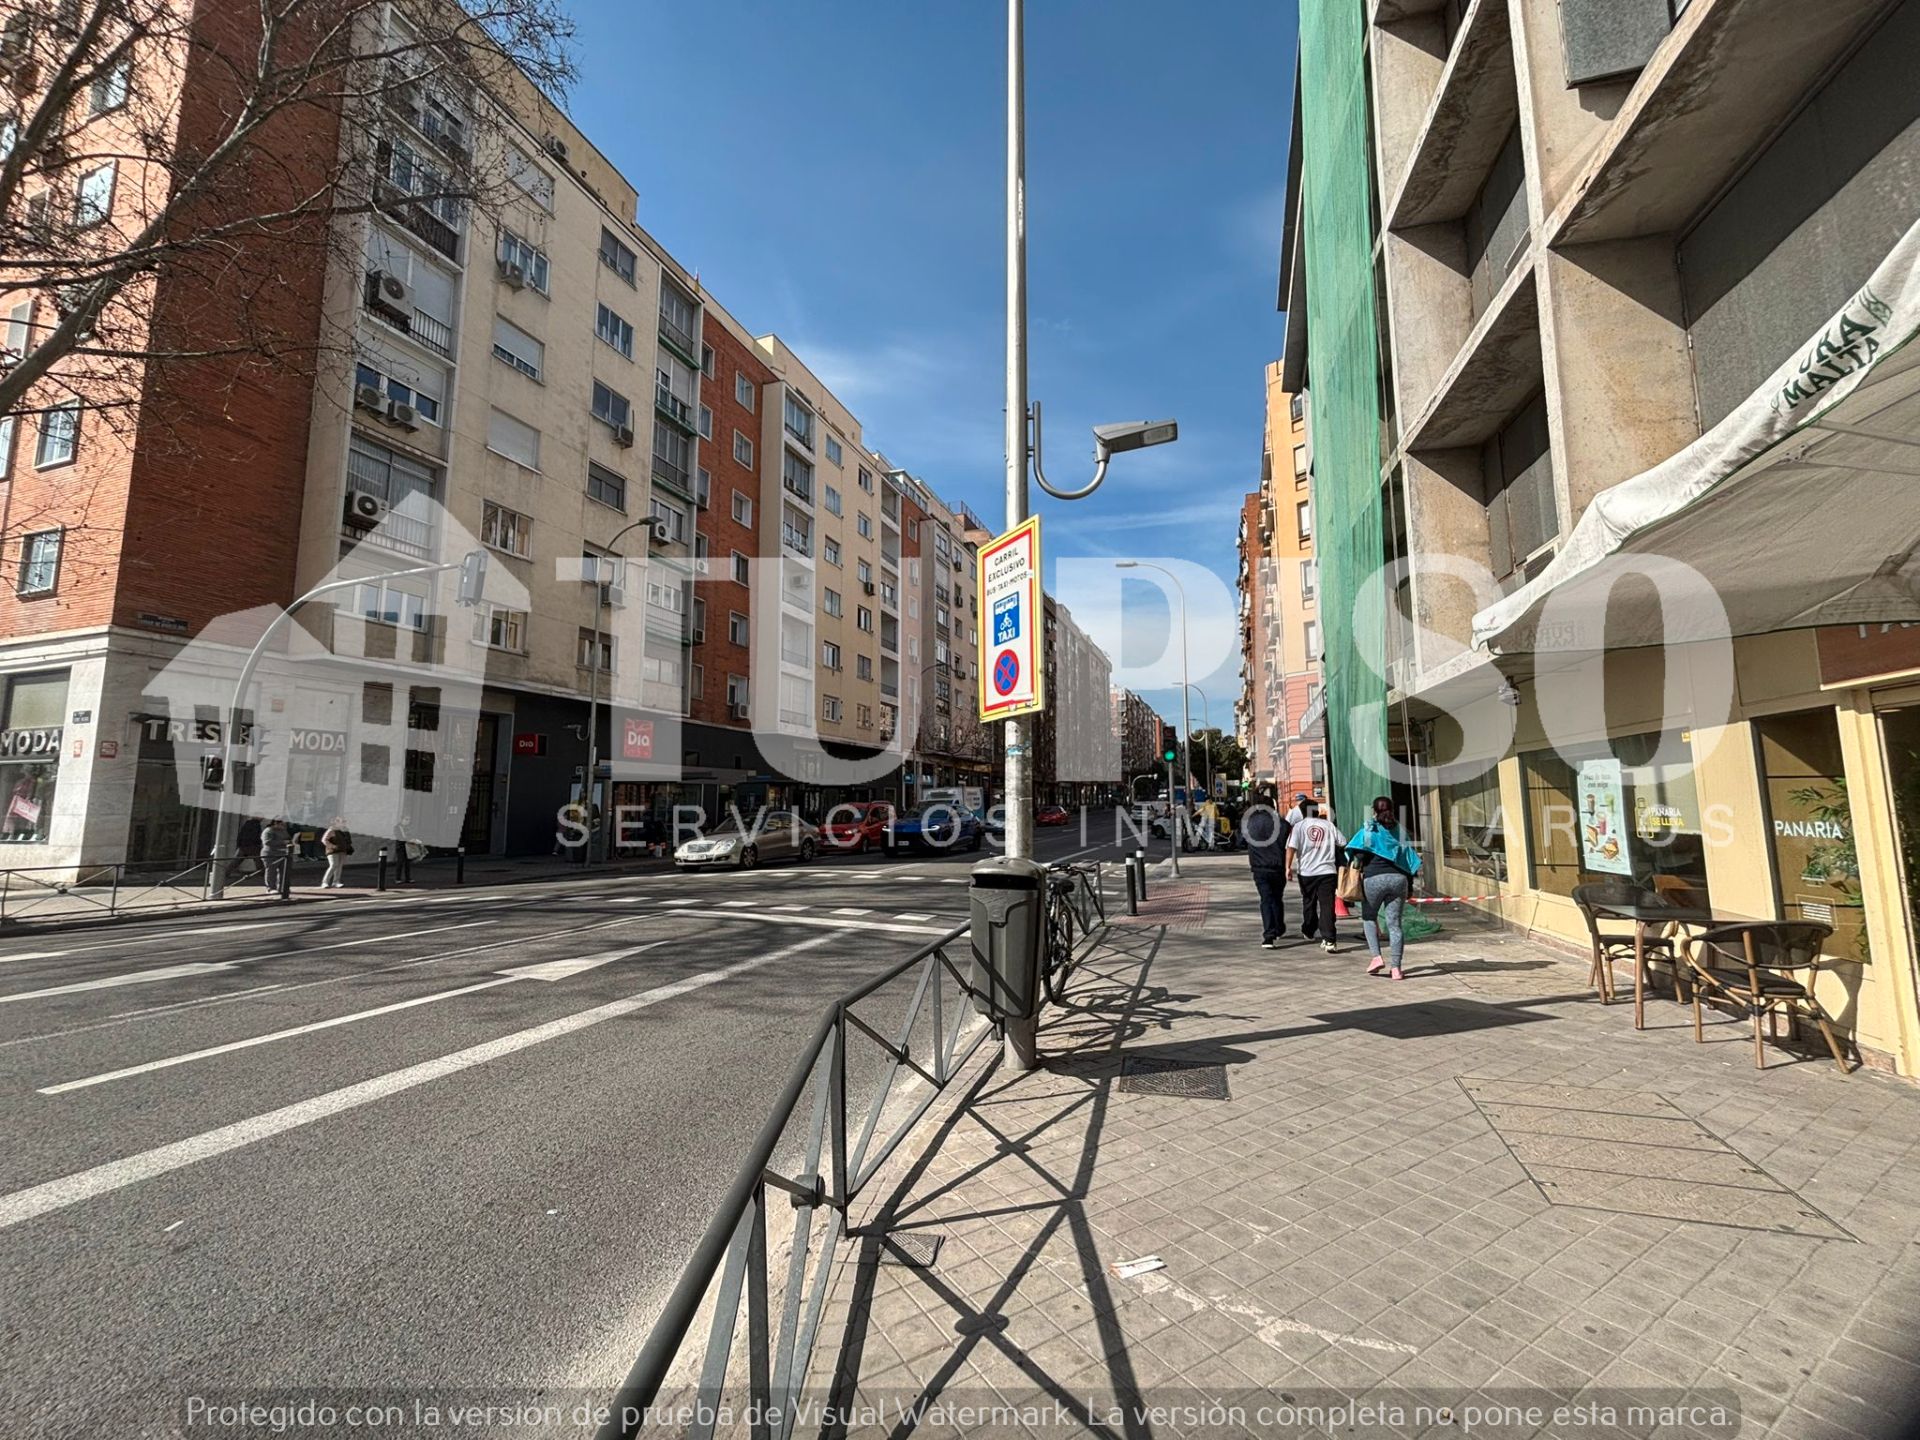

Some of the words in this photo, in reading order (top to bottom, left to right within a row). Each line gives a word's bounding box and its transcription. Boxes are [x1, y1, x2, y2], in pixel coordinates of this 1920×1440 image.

[1782, 336, 1880, 409] MALTA
[994, 548, 1019, 567] CARRIL
[988, 557, 1025, 583] EXCLUSIVO
[998, 626, 1016, 643] TAXI
[0, 729, 61, 757] MODA
[146, 719, 221, 745] TRES
[288, 730, 346, 752] MODA
[1650, 807, 1682, 817] PANARIA
[1774, 820, 1844, 839] PANARIA
